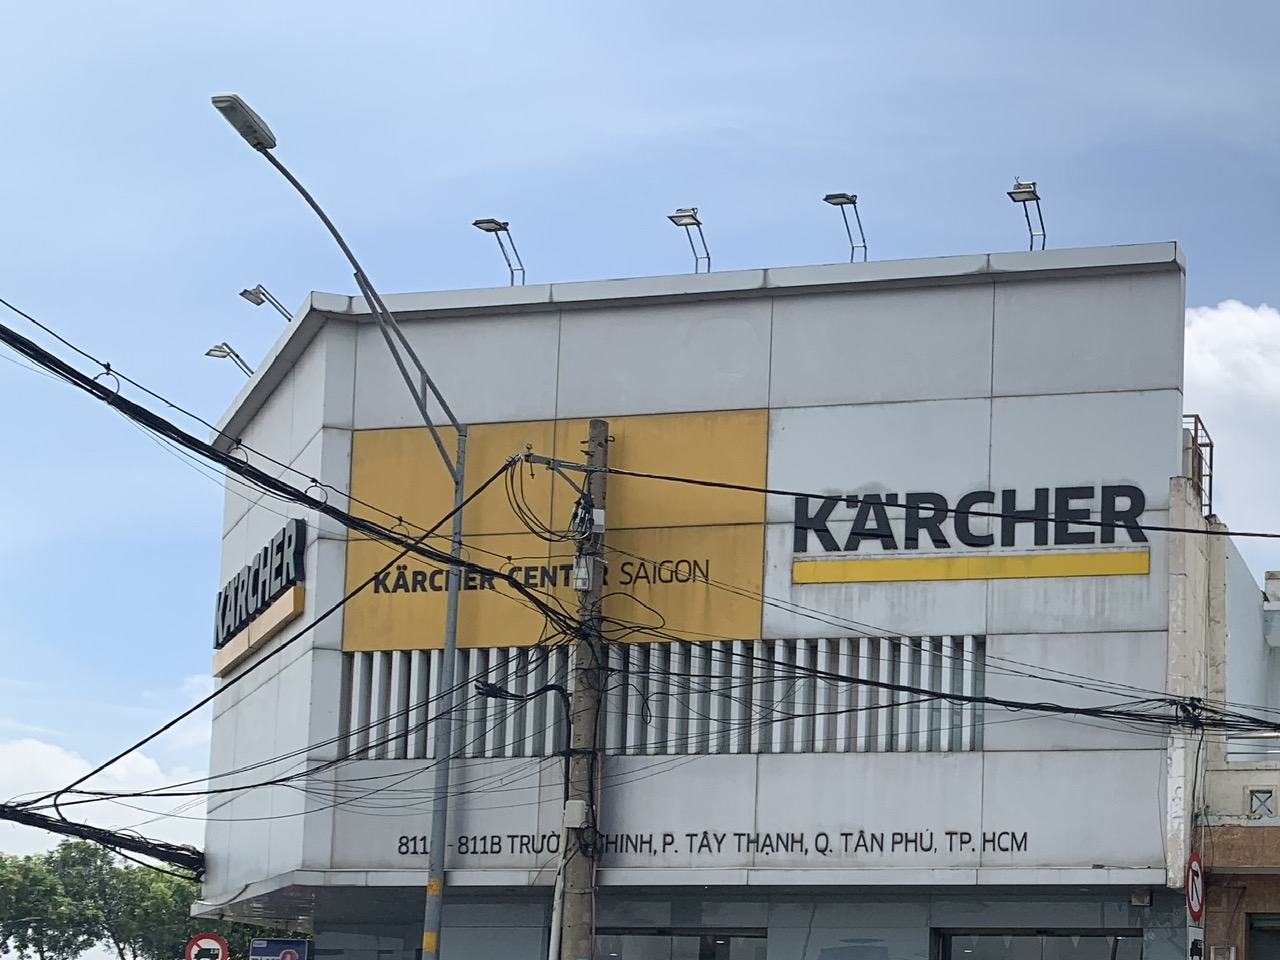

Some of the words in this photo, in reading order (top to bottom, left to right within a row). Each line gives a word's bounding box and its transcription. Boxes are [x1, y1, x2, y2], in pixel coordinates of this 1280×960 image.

[793, 484, 1149, 553] KÄRCHER
[213, 518, 306, 650] KÄRCHER
[507, 564, 609, 588] CENT
[619, 558, 710, 586] SAIGON
[457, 835, 502, 855] 811B
[507, 830, 561, 854] TRƯỜ
[603, 833, 657, 856] HINH,
[685, 831, 727, 853] TÂY
[733, 832, 809, 856] THẠNH,
[814, 832, 833, 856] Q.
[840, 829, 885, 854] TÂN
[891, 828, 938, 855] PHÚ,
[945, 832, 976, 853] TP.
[982, 831, 1028, 853] HCM
